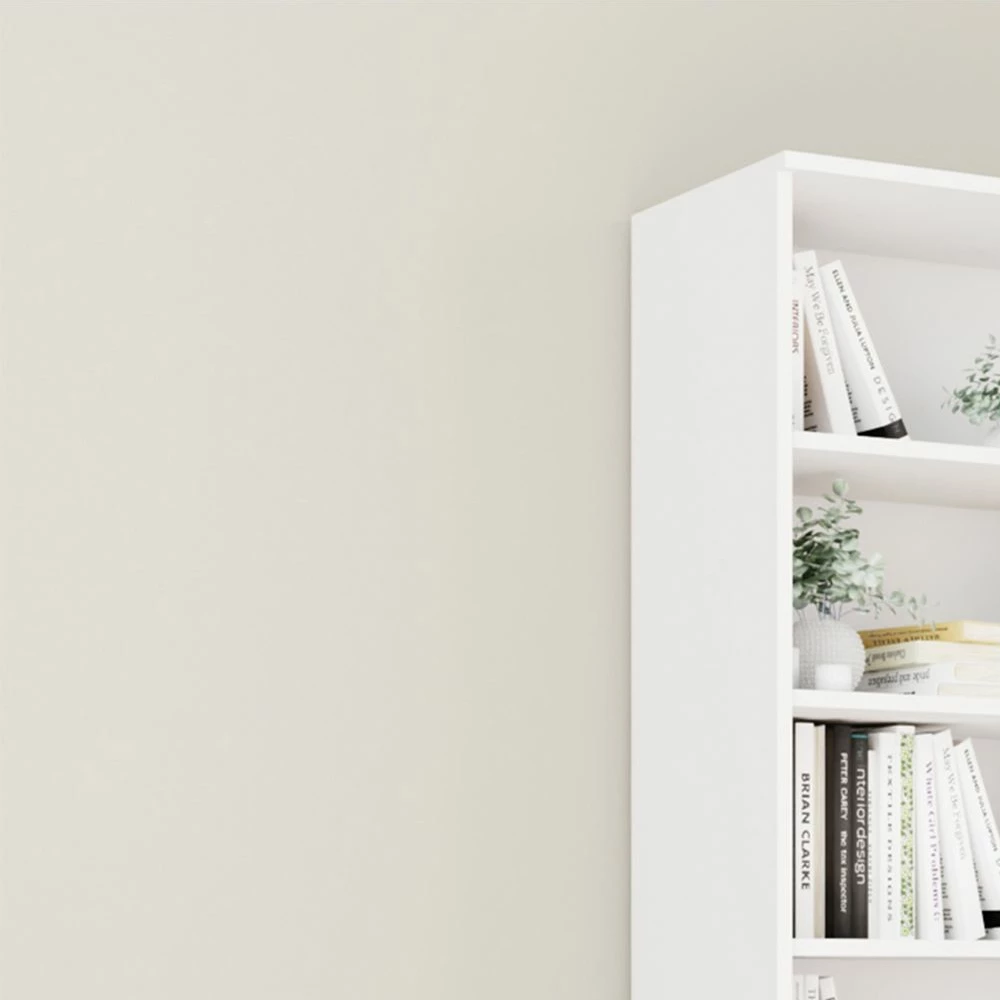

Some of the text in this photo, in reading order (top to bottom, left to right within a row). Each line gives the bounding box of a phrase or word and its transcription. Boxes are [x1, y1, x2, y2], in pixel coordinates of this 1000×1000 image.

[804, 265, 816, 289] May
[832, 269, 845, 293] ELLEN
[842, 294, 853, 312] AND
[811, 291, 821, 310] We
[814, 311, 825, 328] Be
[840, 752, 849, 821] PETER CAREY
[801, 773, 811, 891] BRIAN CLARKE
